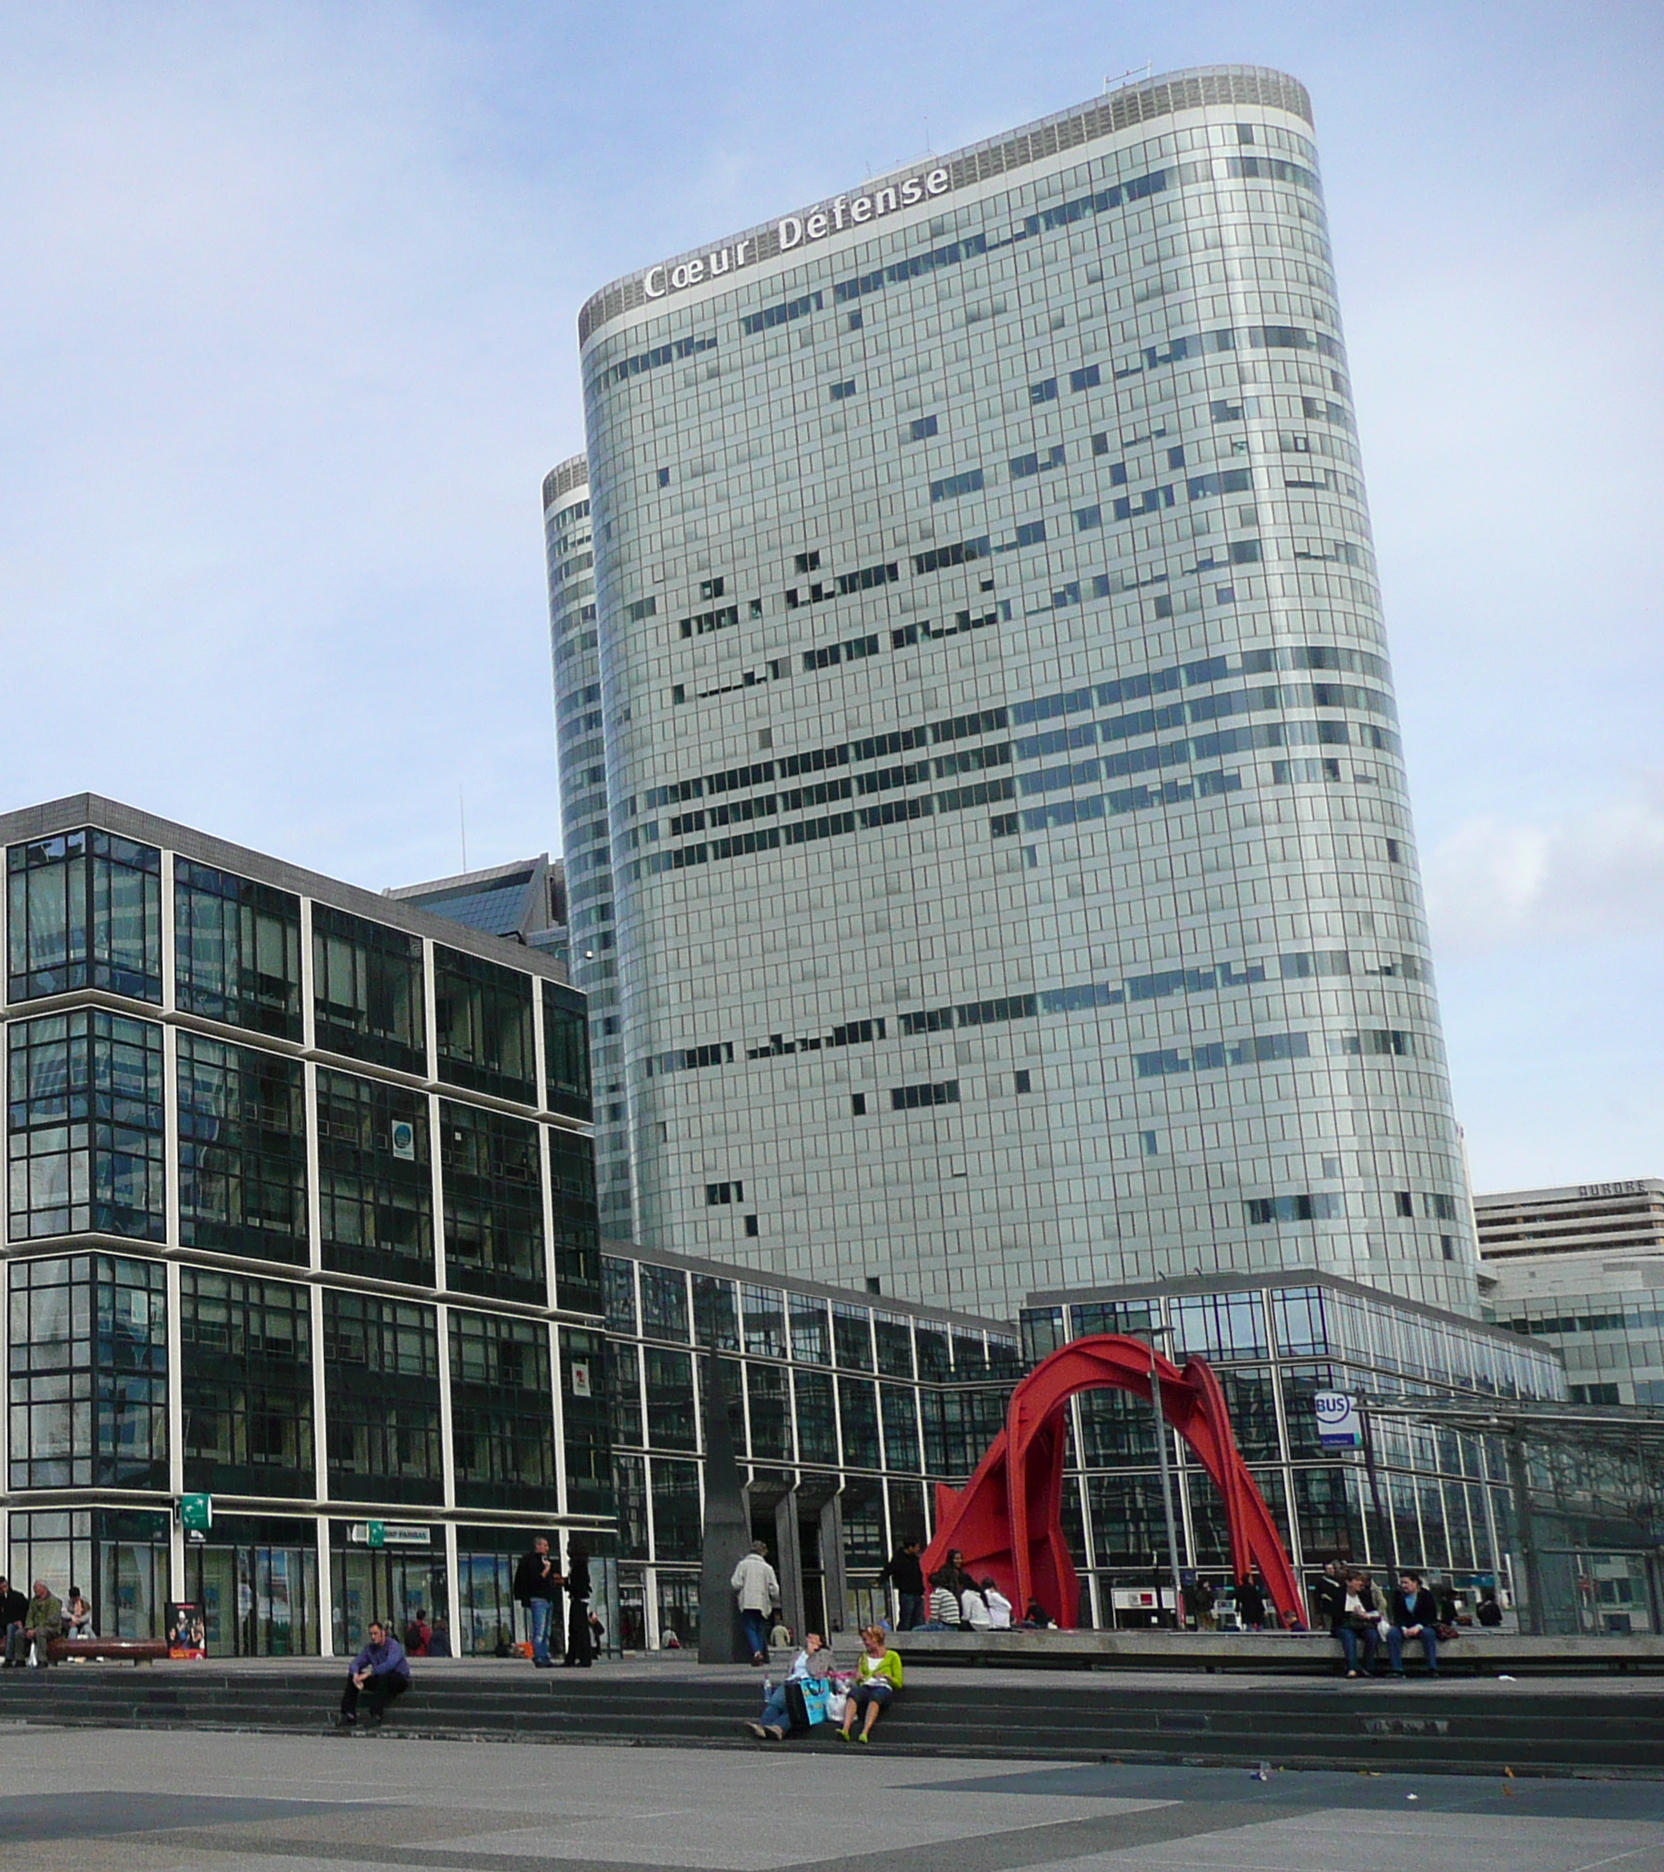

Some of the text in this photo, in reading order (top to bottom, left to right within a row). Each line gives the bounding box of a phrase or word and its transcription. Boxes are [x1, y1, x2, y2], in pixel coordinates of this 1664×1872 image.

[644, 167, 949, 298] Cœur Défense
[1578, 1180, 1646, 1198] AURORE
[1316, 1397, 1345, 1412] BUS
